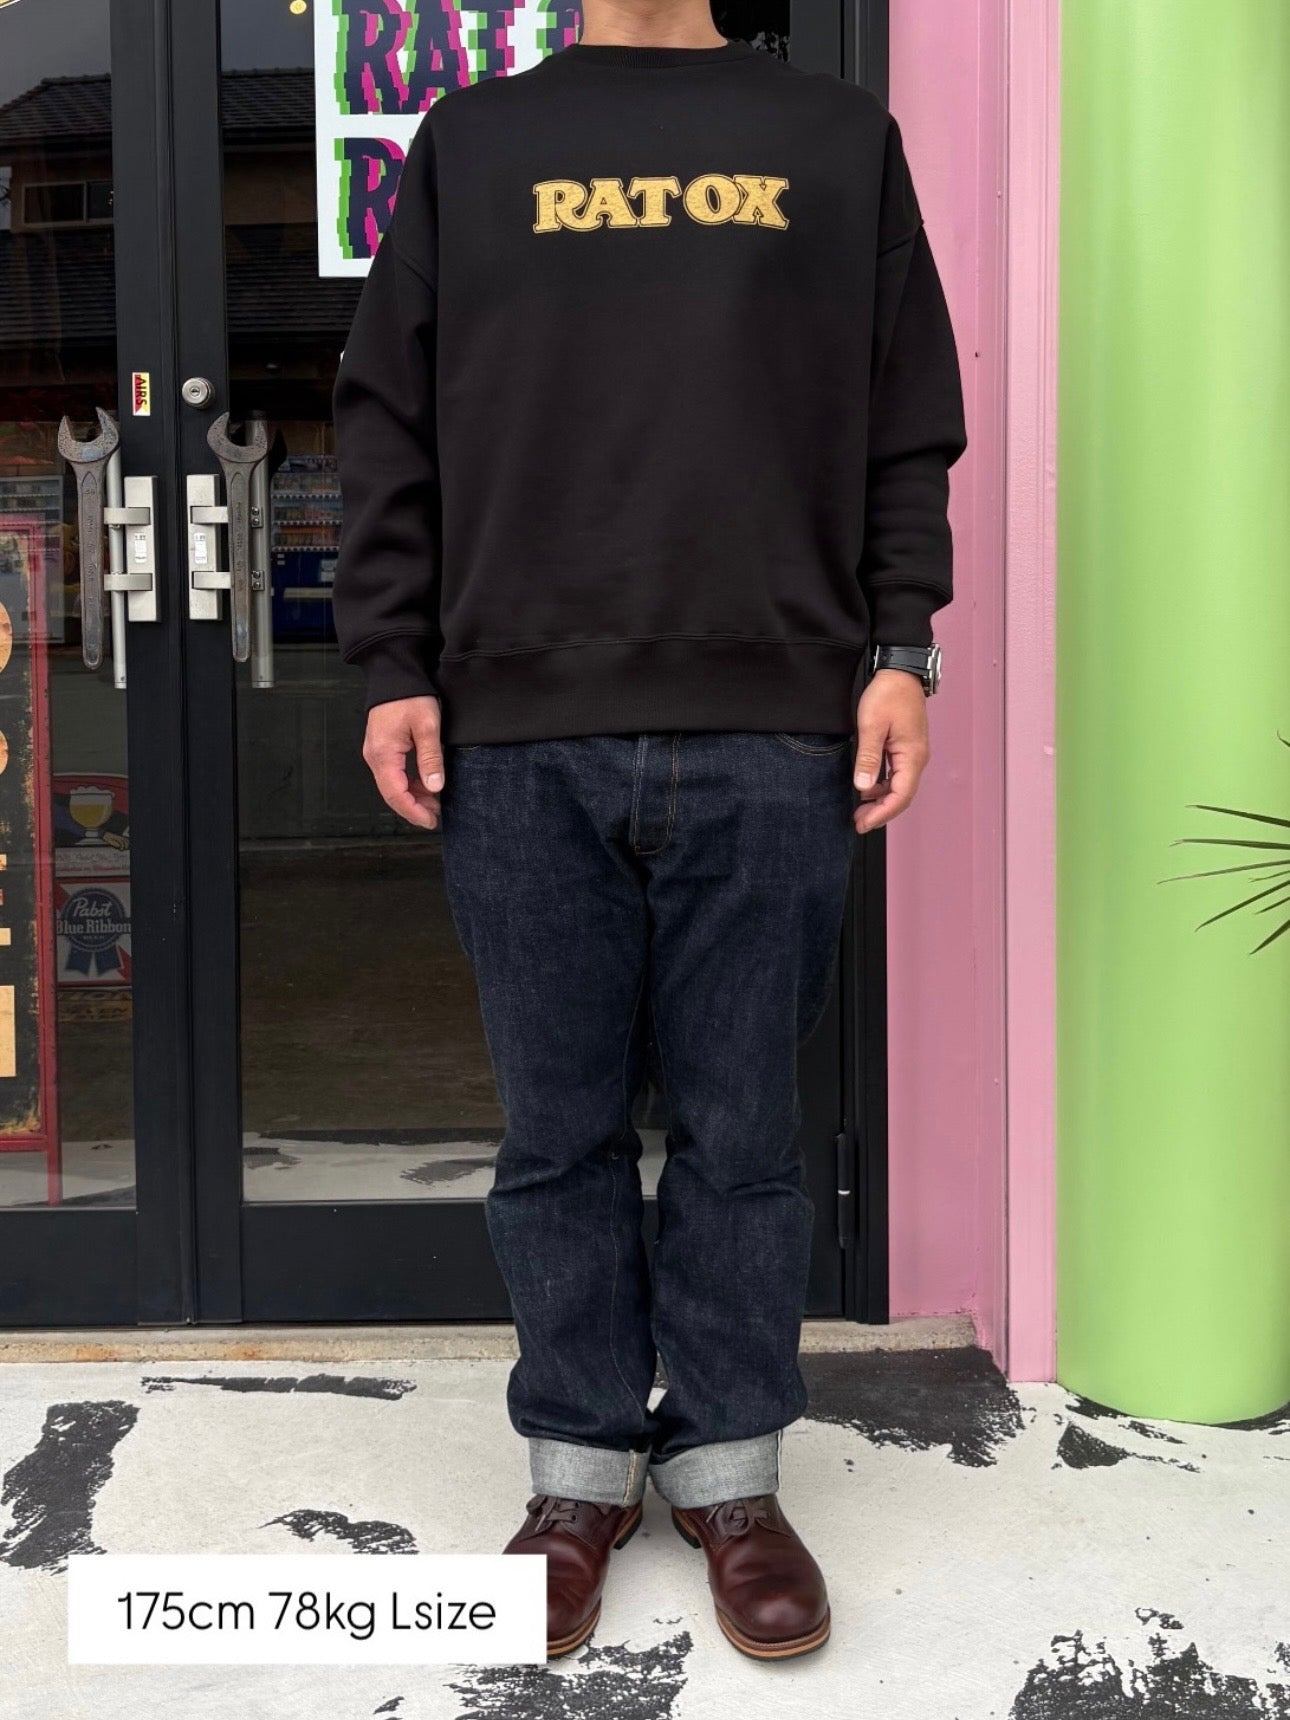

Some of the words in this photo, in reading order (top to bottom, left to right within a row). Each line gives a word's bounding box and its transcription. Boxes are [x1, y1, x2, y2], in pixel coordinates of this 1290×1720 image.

[71, 896, 113, 917] Pabst
[56, 919, 84, 935] Blue
[86, 918, 132, 934] Ribbon
